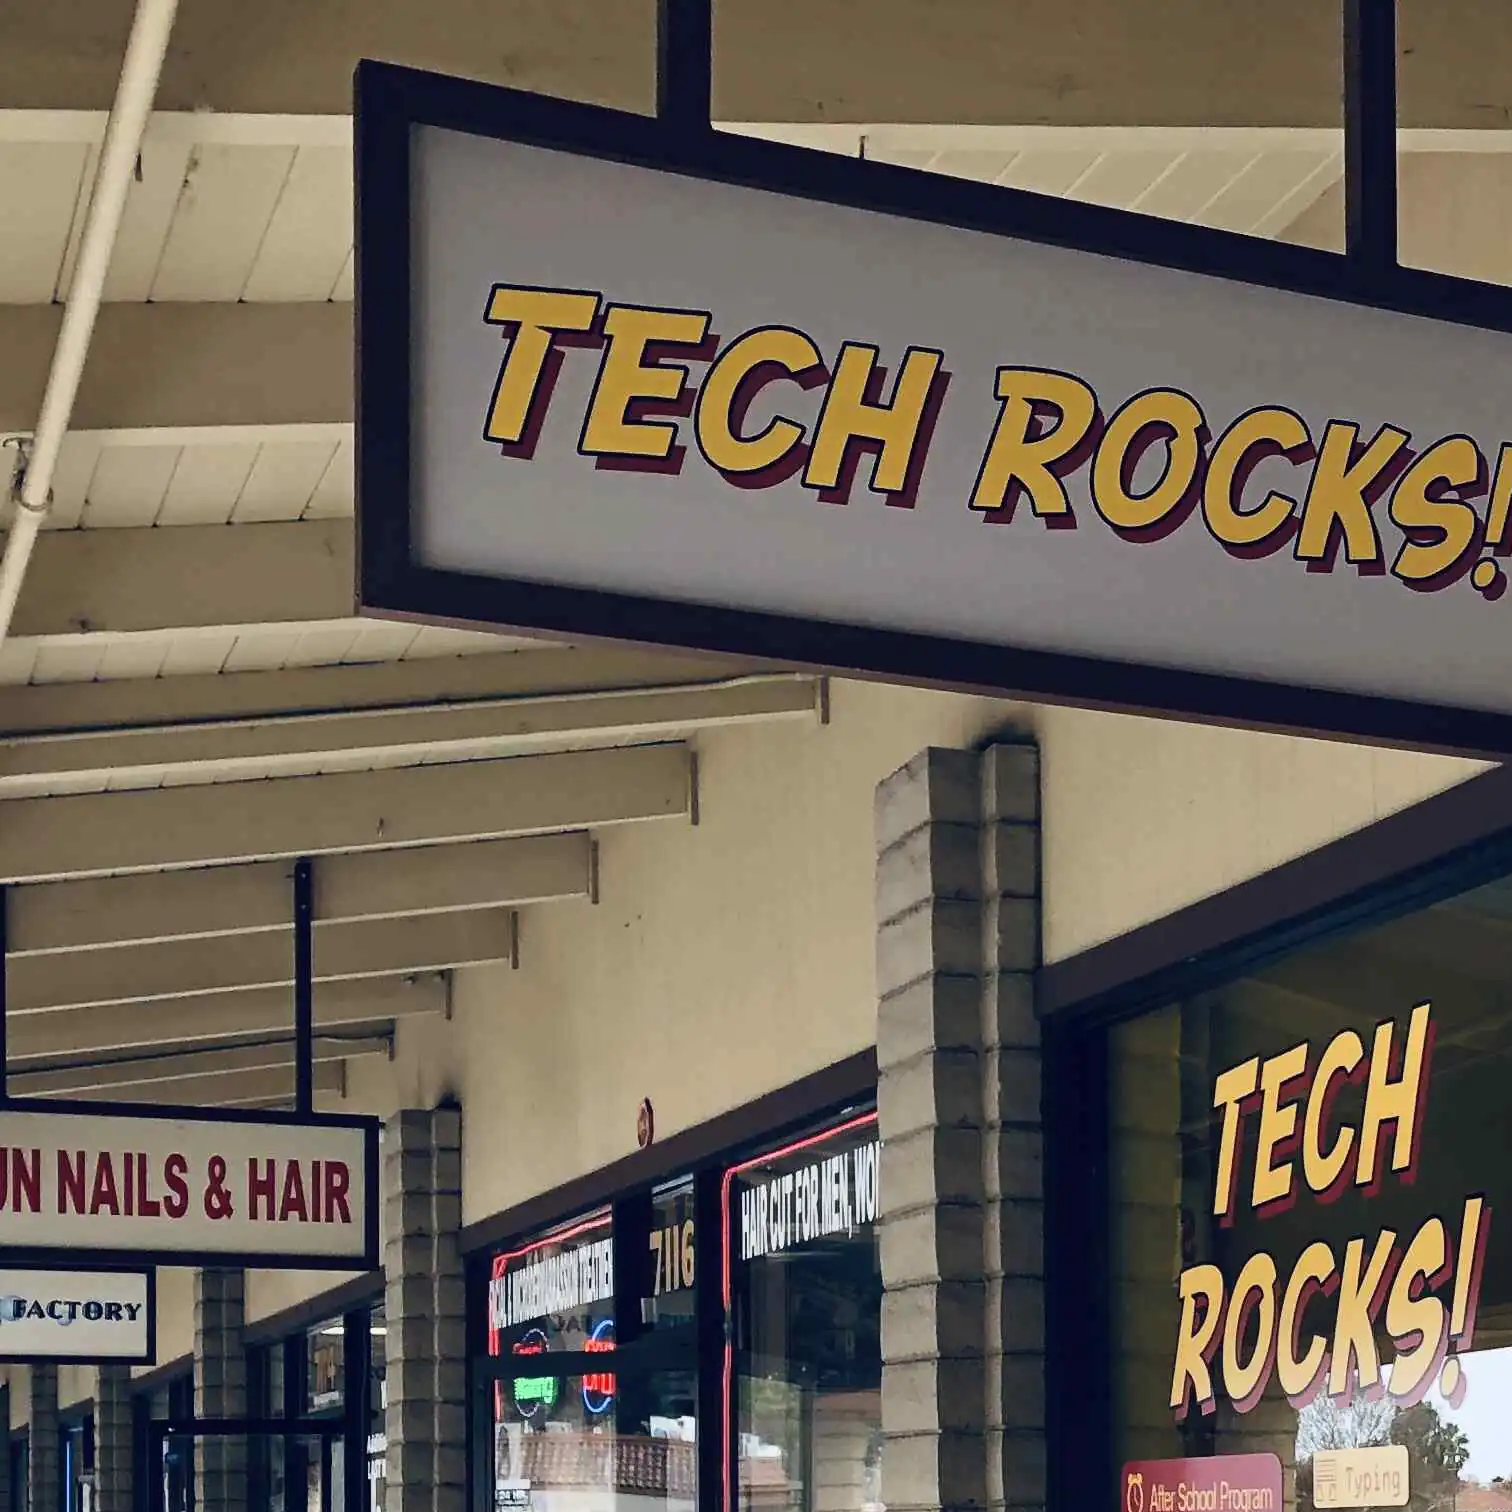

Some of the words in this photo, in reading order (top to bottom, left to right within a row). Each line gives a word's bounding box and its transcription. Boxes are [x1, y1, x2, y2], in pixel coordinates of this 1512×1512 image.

[483, 283, 950, 507] TECH
[1213, 1000, 1438, 1228] TECH
[58, 1150, 189, 1219] NAILS
[204, 1155, 234, 1220] &
[248, 1157, 352, 1224] HAIR
[742, 1184, 768, 1260] HAIR
[770, 1173, 793, 1252] CUT
[795, 1164, 819, 1241] FOR
[649, 1219, 695, 1296] 7116
[12, 1299, 142, 1322] FACTORY
[1169, 1192, 1493, 1423] ROCKS!
[1150, 1484, 1176, 1512] After
[1178, 1482, 1216, 1512] School
[1345, 1464, 1401, 1498] Typing
